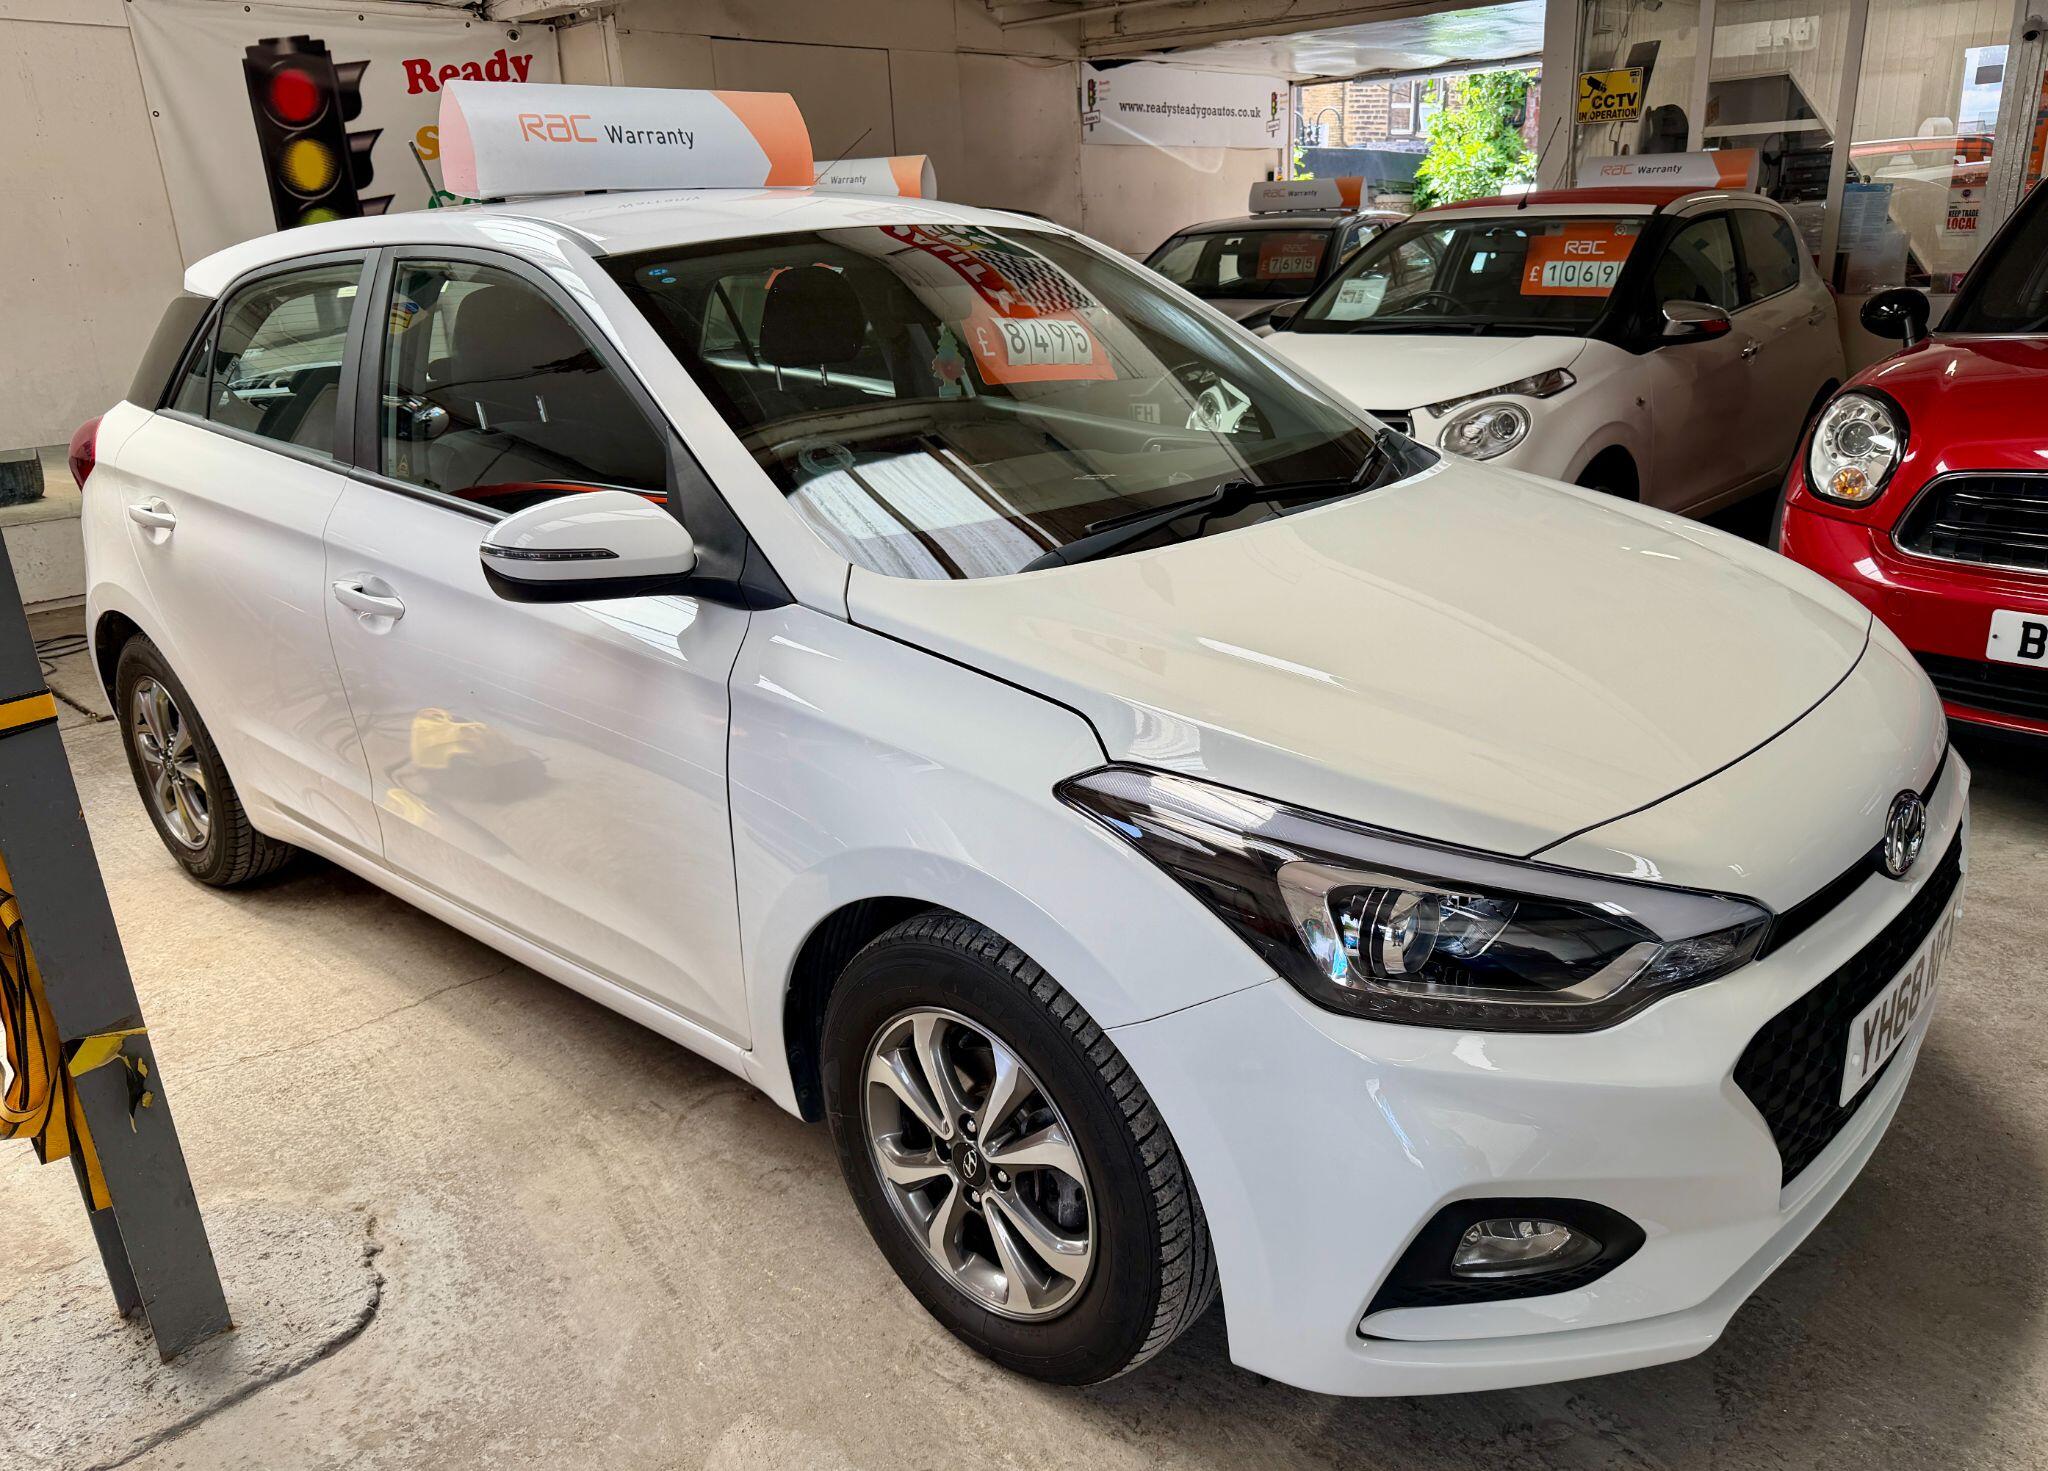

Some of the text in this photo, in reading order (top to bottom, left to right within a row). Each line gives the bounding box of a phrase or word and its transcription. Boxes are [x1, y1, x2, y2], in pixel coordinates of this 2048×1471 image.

[402, 49, 533, 95] Ready
[1591, 92, 1637, 109] CCTV
[1119, 102, 1261, 118] www.readysteadygoautos.co.uk
[1579, 108, 1637, 120] IN OPERATION
[604, 125, 695, 149] Warranty
[1638, 165, 1682, 174] Warranty
[830, 175, 867, 185] Warranty
[1948, 209, 1961, 217] KEEP
[1946, 217, 1976, 230] LOCAL
[1271, 257, 1313, 271] 7695
[1004, 323, 1087, 354] 8495
[1862, 954, 1925, 1077] YH68
